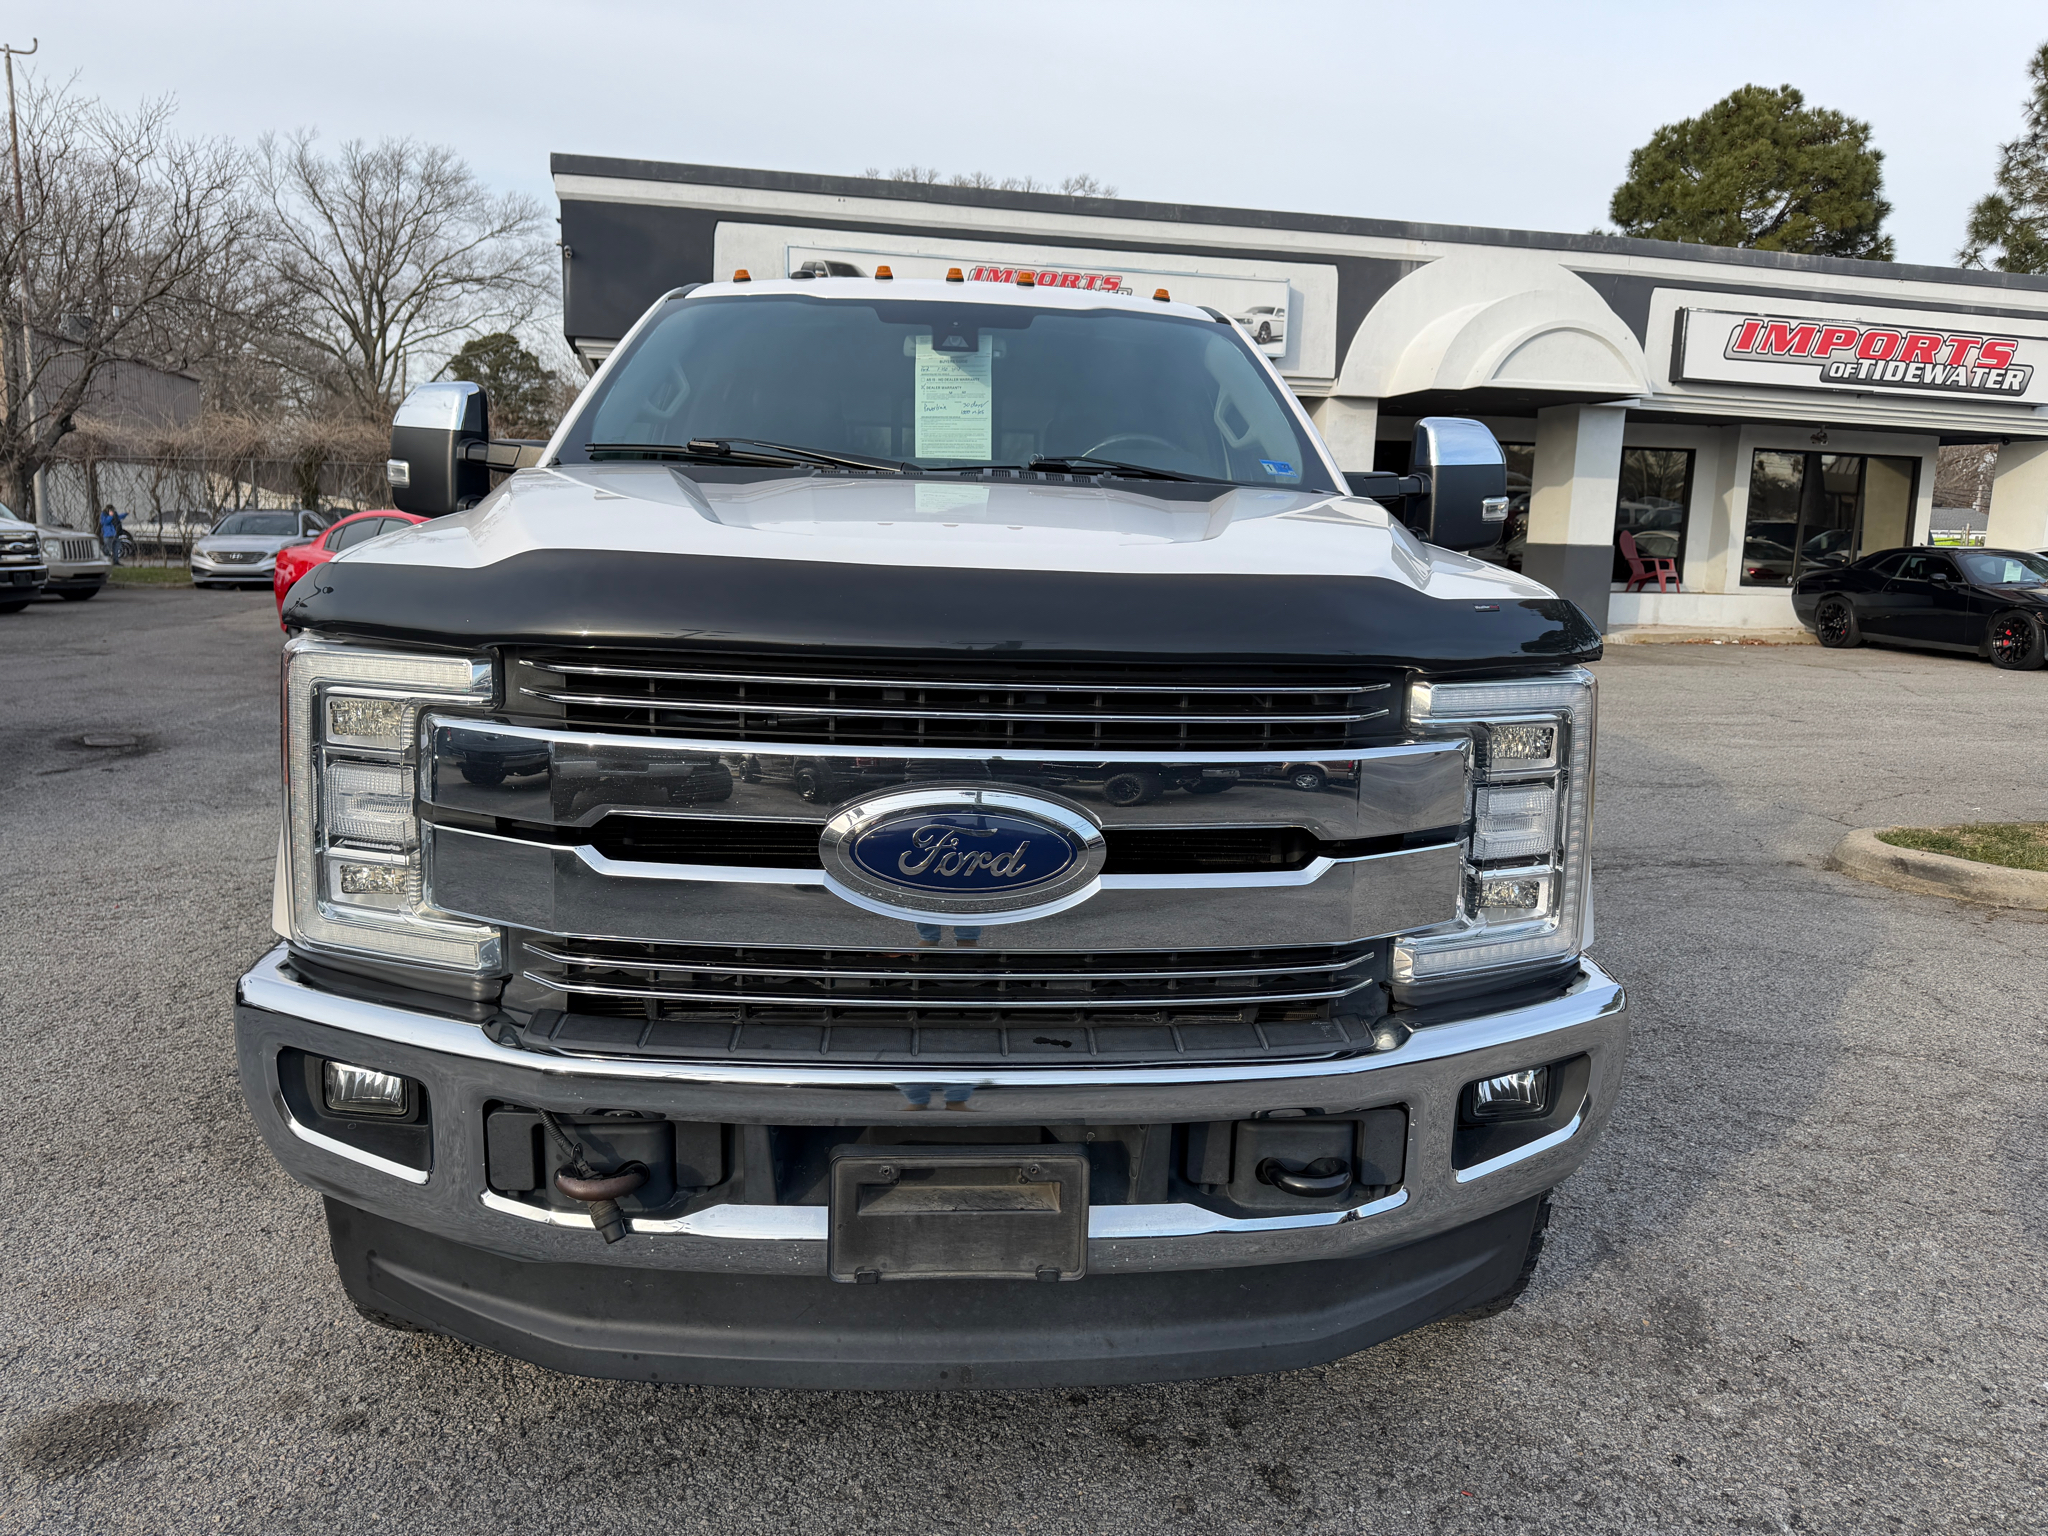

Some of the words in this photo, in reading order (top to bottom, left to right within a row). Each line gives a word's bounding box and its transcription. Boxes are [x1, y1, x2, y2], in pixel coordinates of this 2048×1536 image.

[1732, 319, 2018, 369] IMPORTS
[1828, 363, 1856, 379] OF
[1855, 359, 2026, 390] TIDEWATER
[898, 824, 1030, 877] Ford
